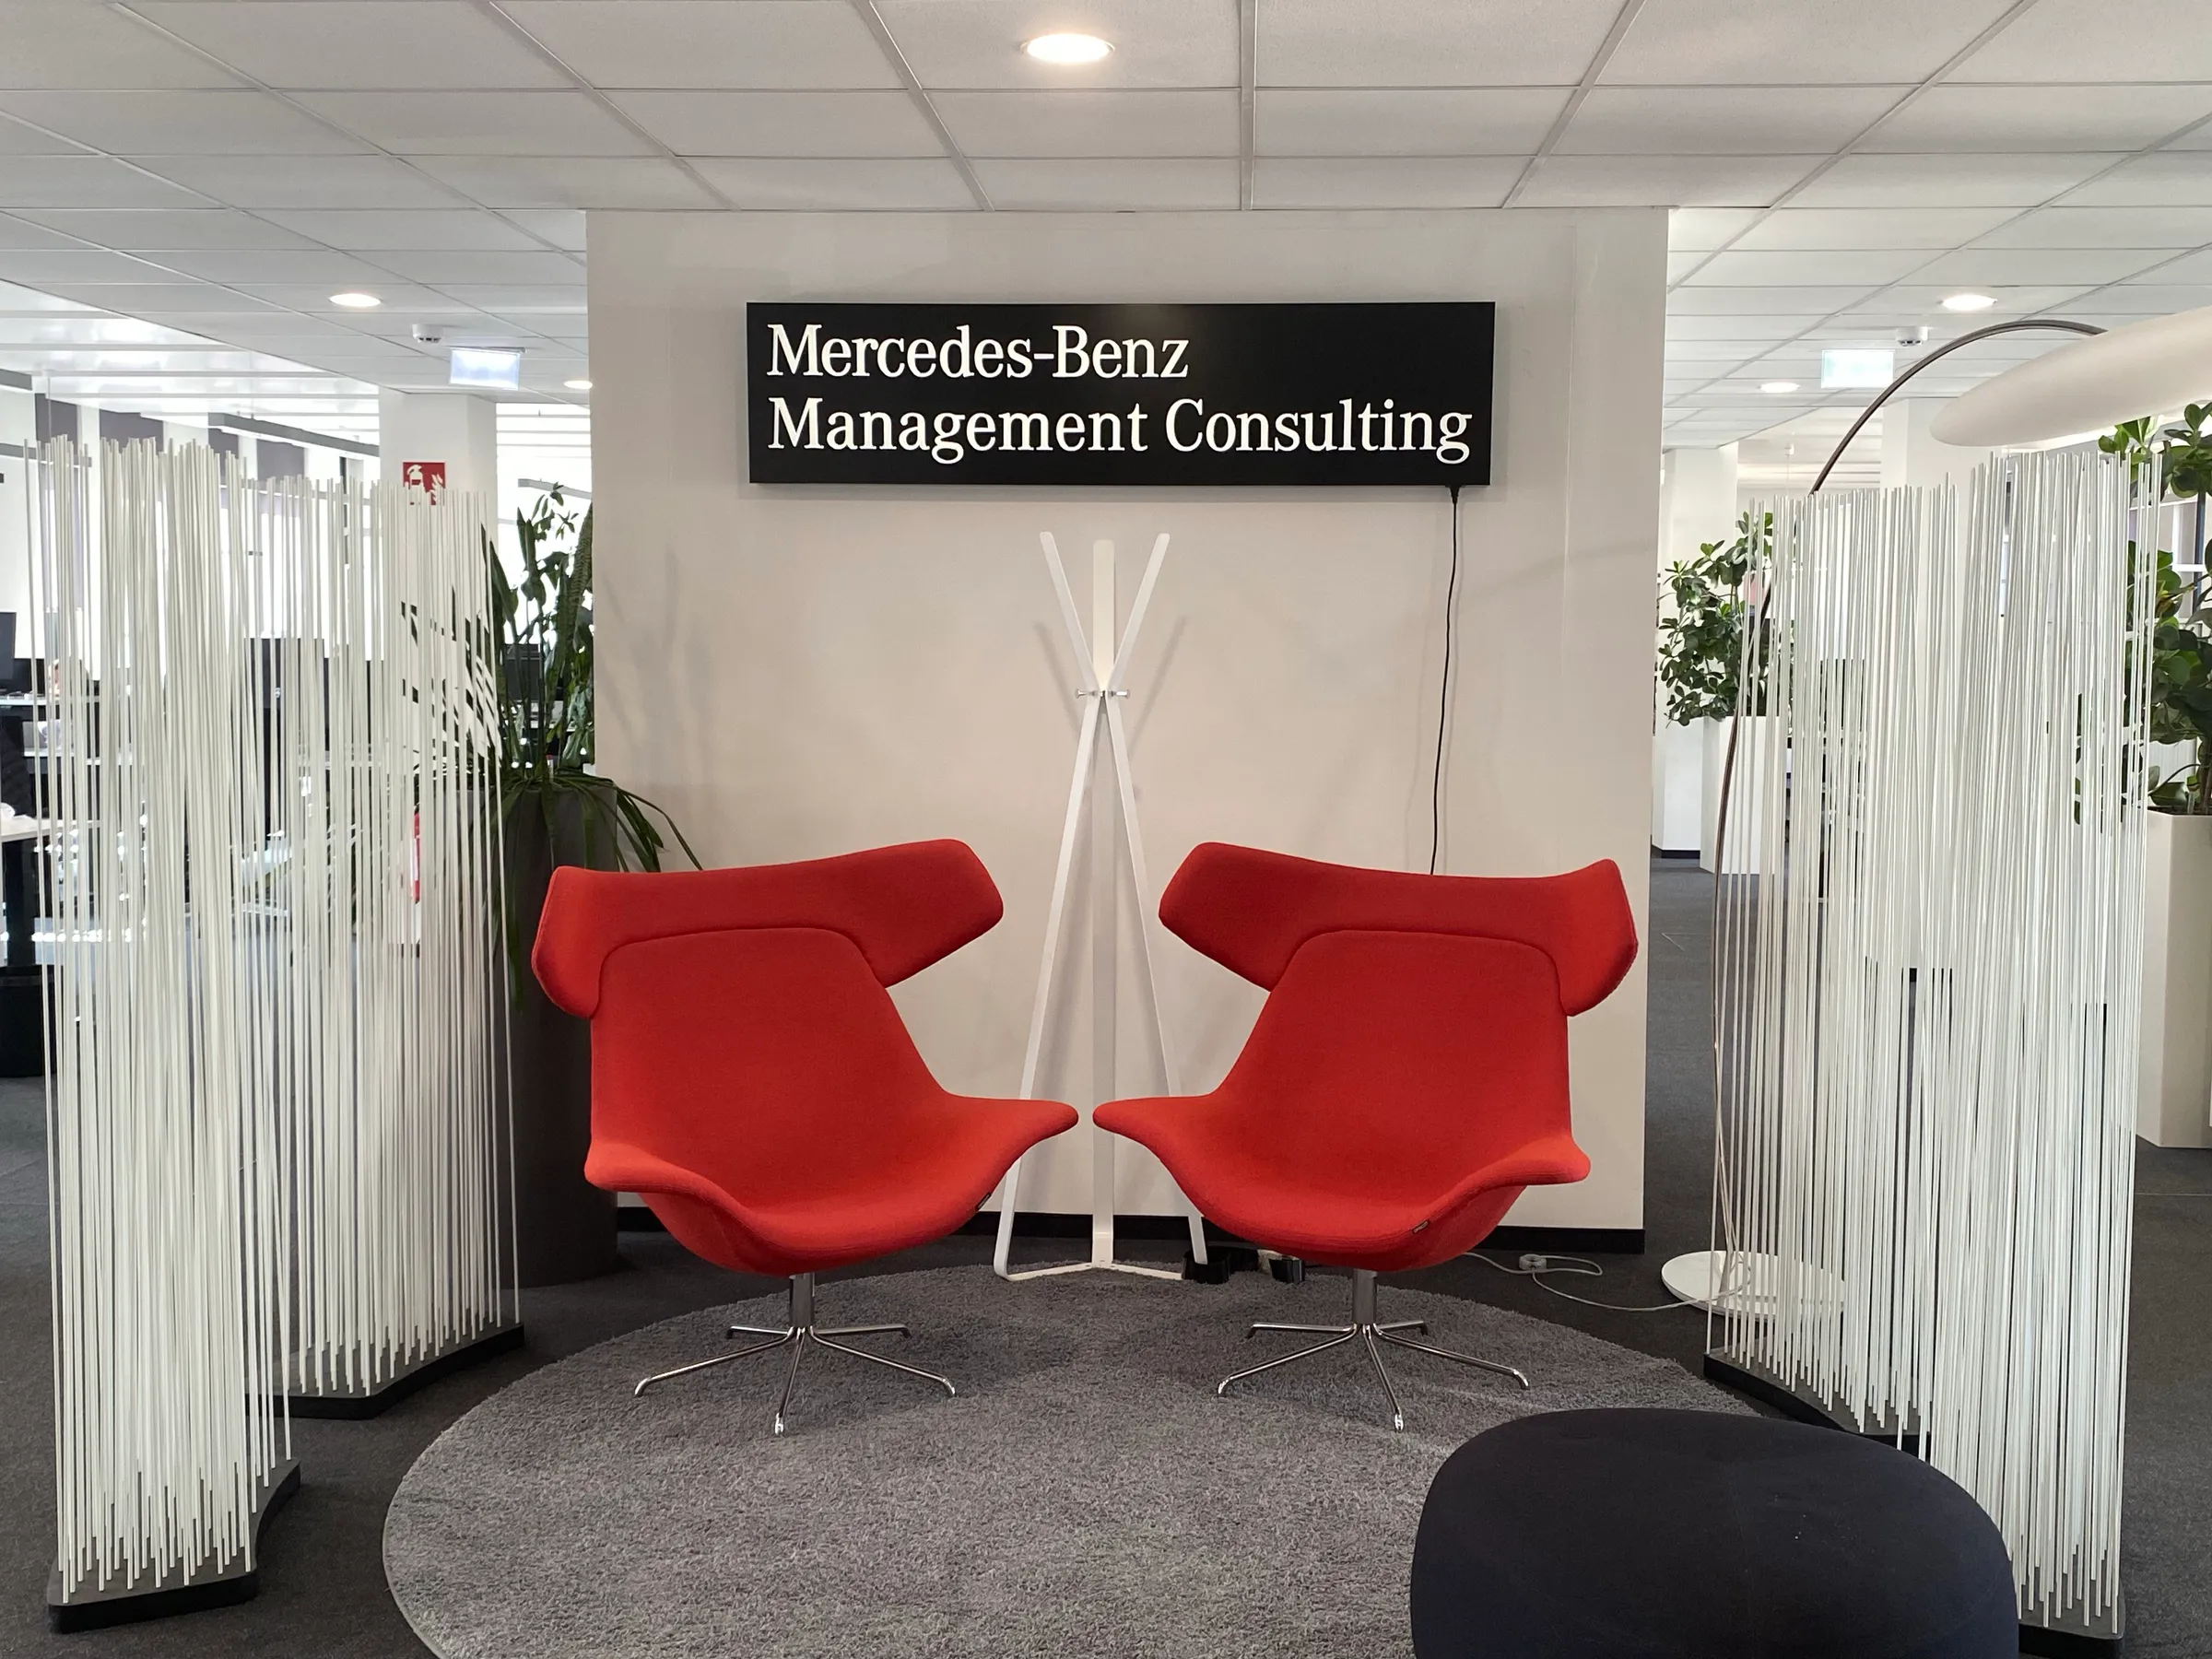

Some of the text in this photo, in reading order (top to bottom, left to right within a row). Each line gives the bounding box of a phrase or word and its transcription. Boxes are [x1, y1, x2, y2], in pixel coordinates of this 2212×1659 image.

[766, 324, 1189, 379] Mercedes-Benz
[767, 396, 1473, 465] Management Consulting
